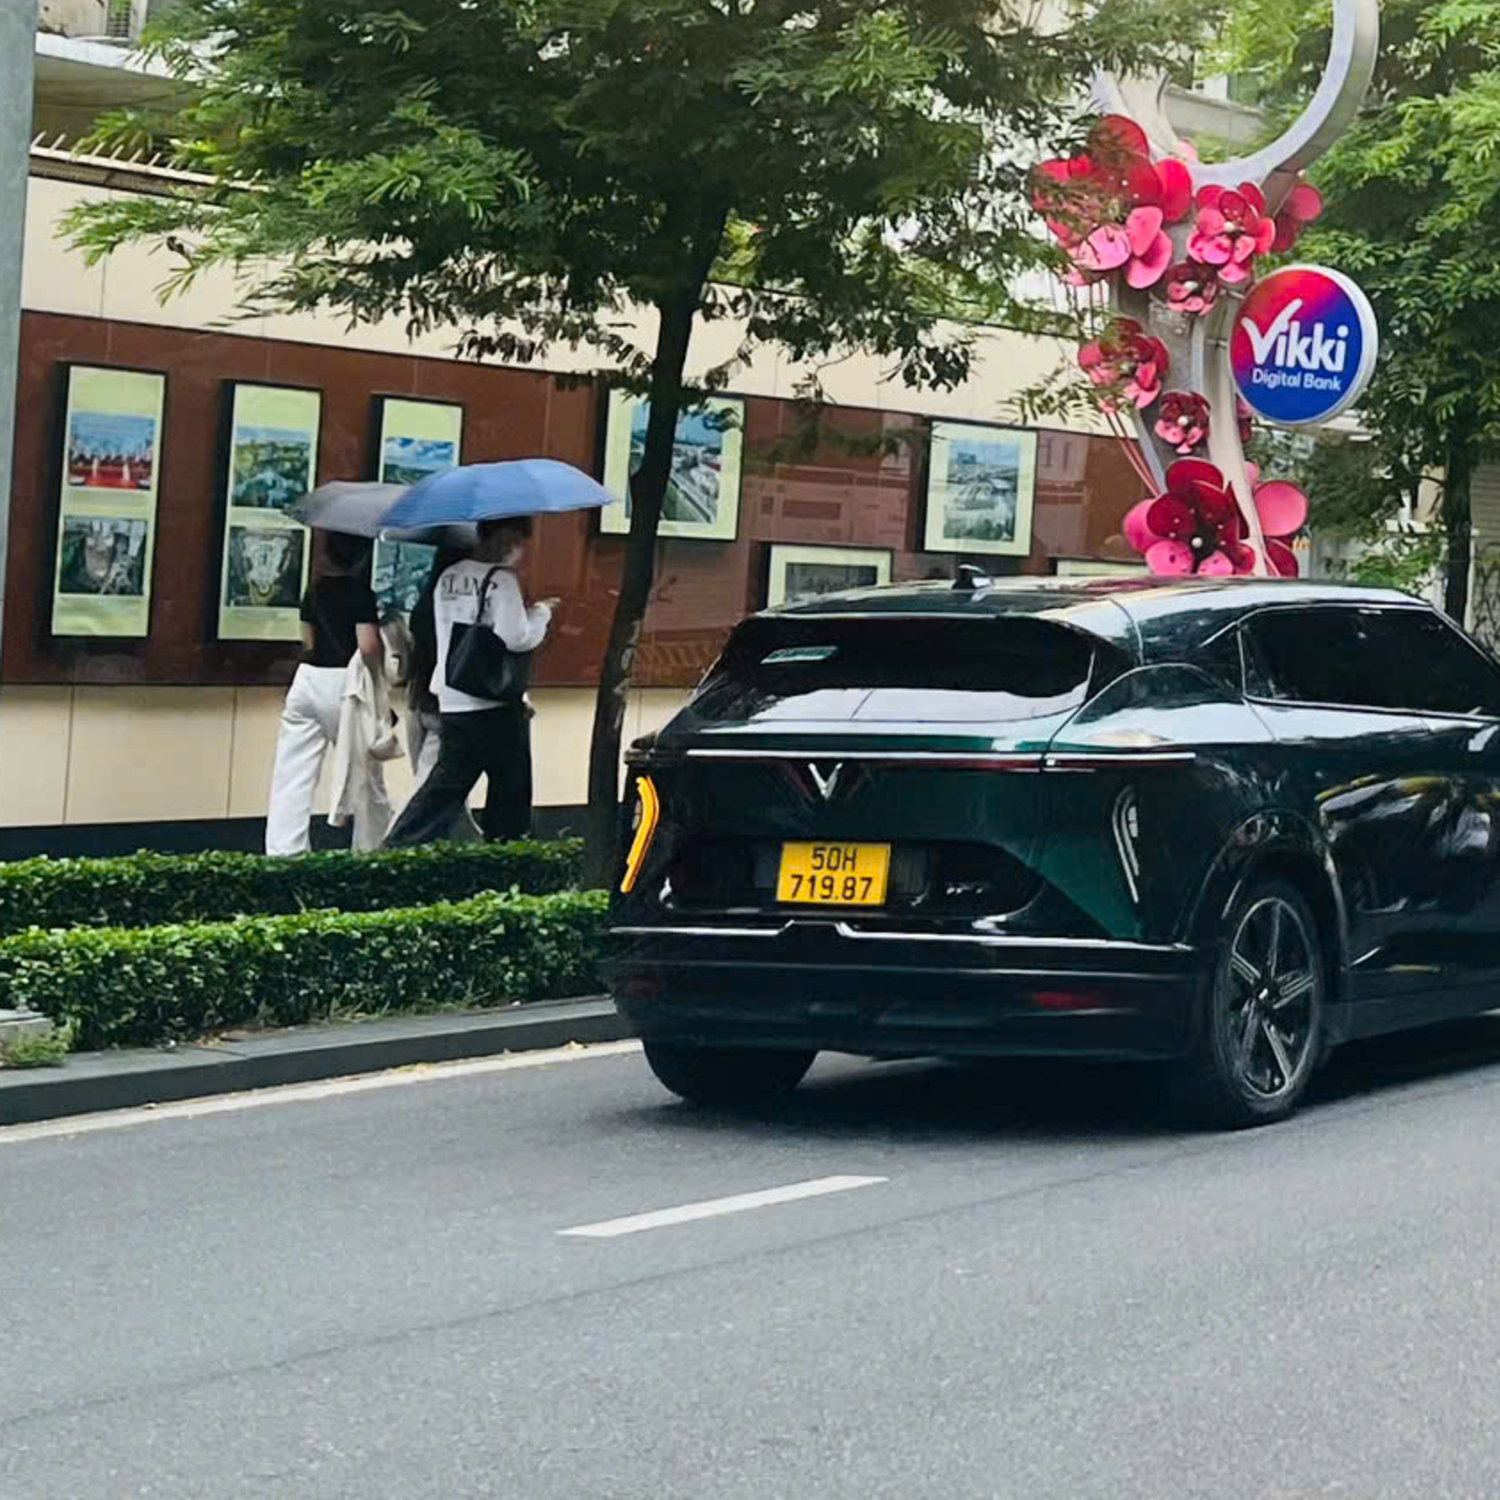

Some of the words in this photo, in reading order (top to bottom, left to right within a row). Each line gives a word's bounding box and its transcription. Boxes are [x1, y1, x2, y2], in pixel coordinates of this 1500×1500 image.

[1240, 297, 1347, 372] Vikki
[1252, 367, 1301, 389] Digital
[1303, 372, 1341, 391] Bank
[811, 846, 858, 871] 50H
[790, 874, 873, 901] 719.87
